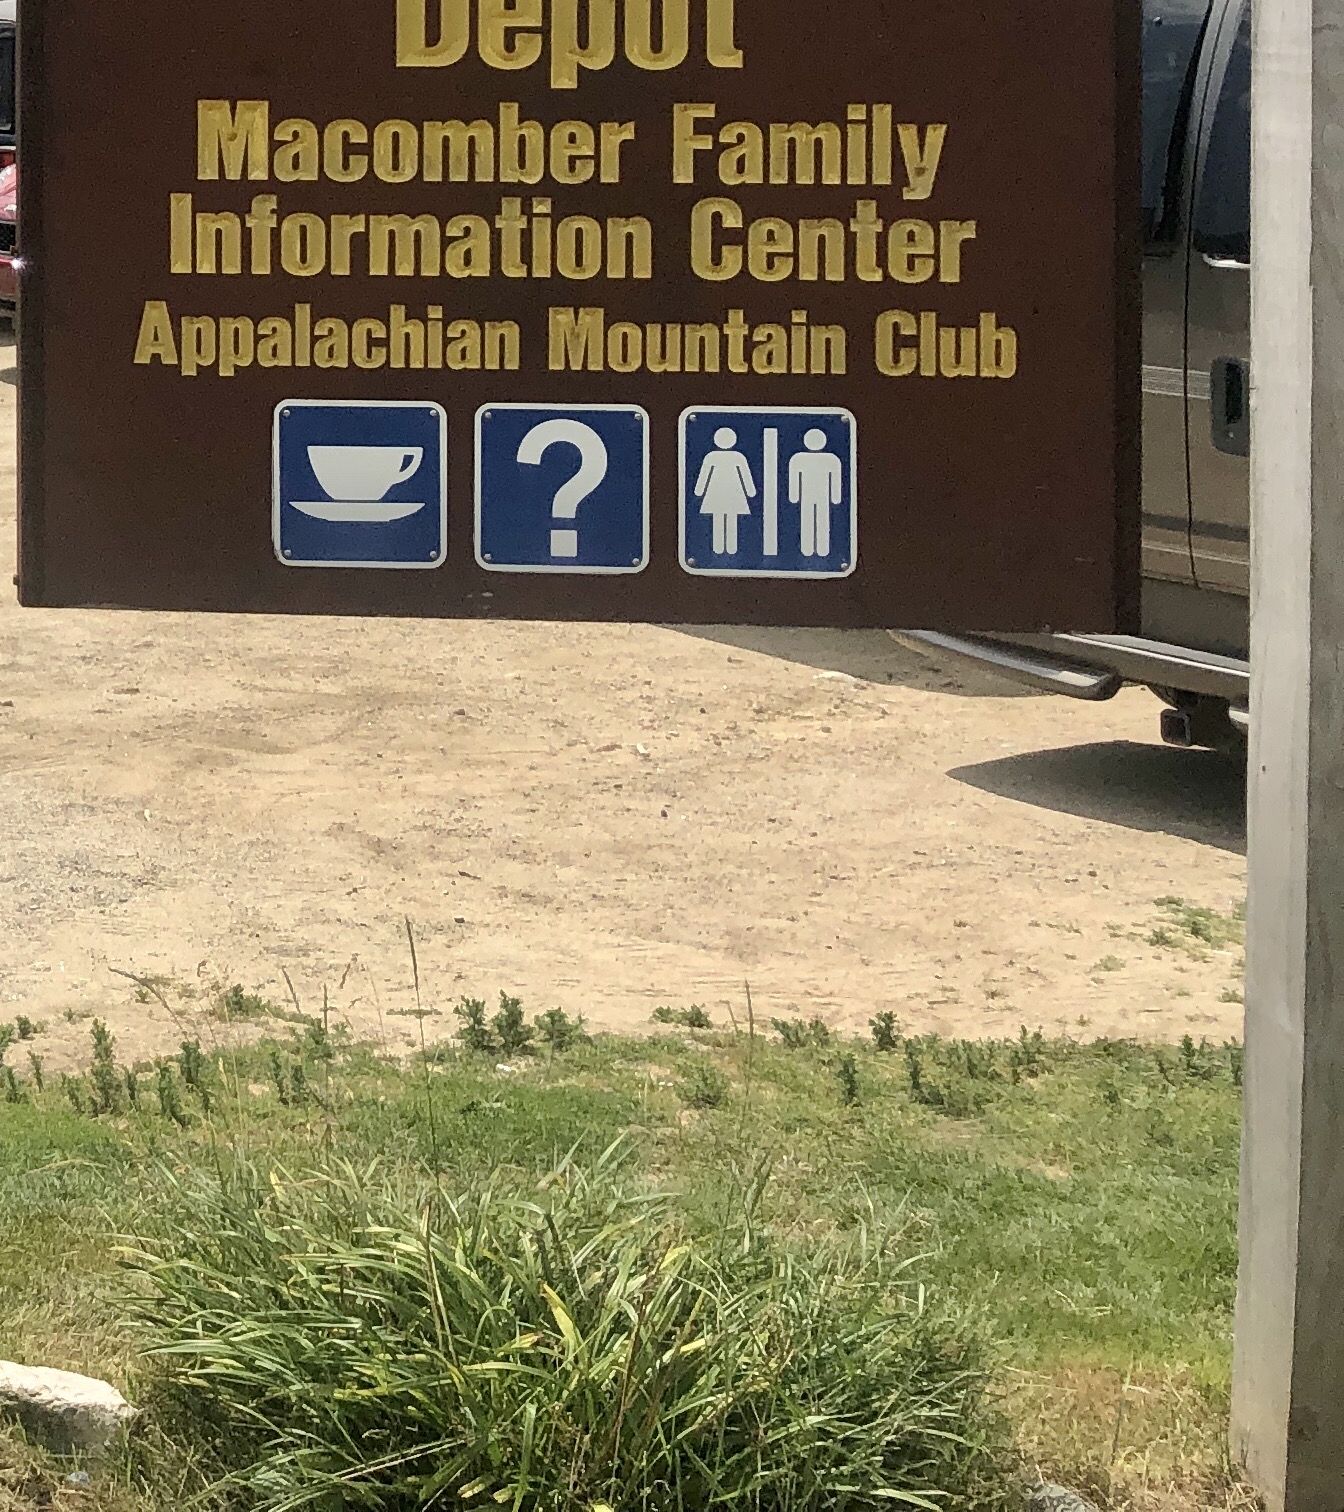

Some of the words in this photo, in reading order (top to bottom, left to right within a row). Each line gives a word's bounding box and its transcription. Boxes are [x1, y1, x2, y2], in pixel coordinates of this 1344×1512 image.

[196, 99, 636, 185] Macomber
[672, 102, 948, 200] Family
[169, 192, 653, 280] Information
[690, 197, 976, 284] Center
[133, 300, 521, 377] Appalachian
[548, 306, 847, 375] Mountain
[874, 309, 1018, 379] Club
